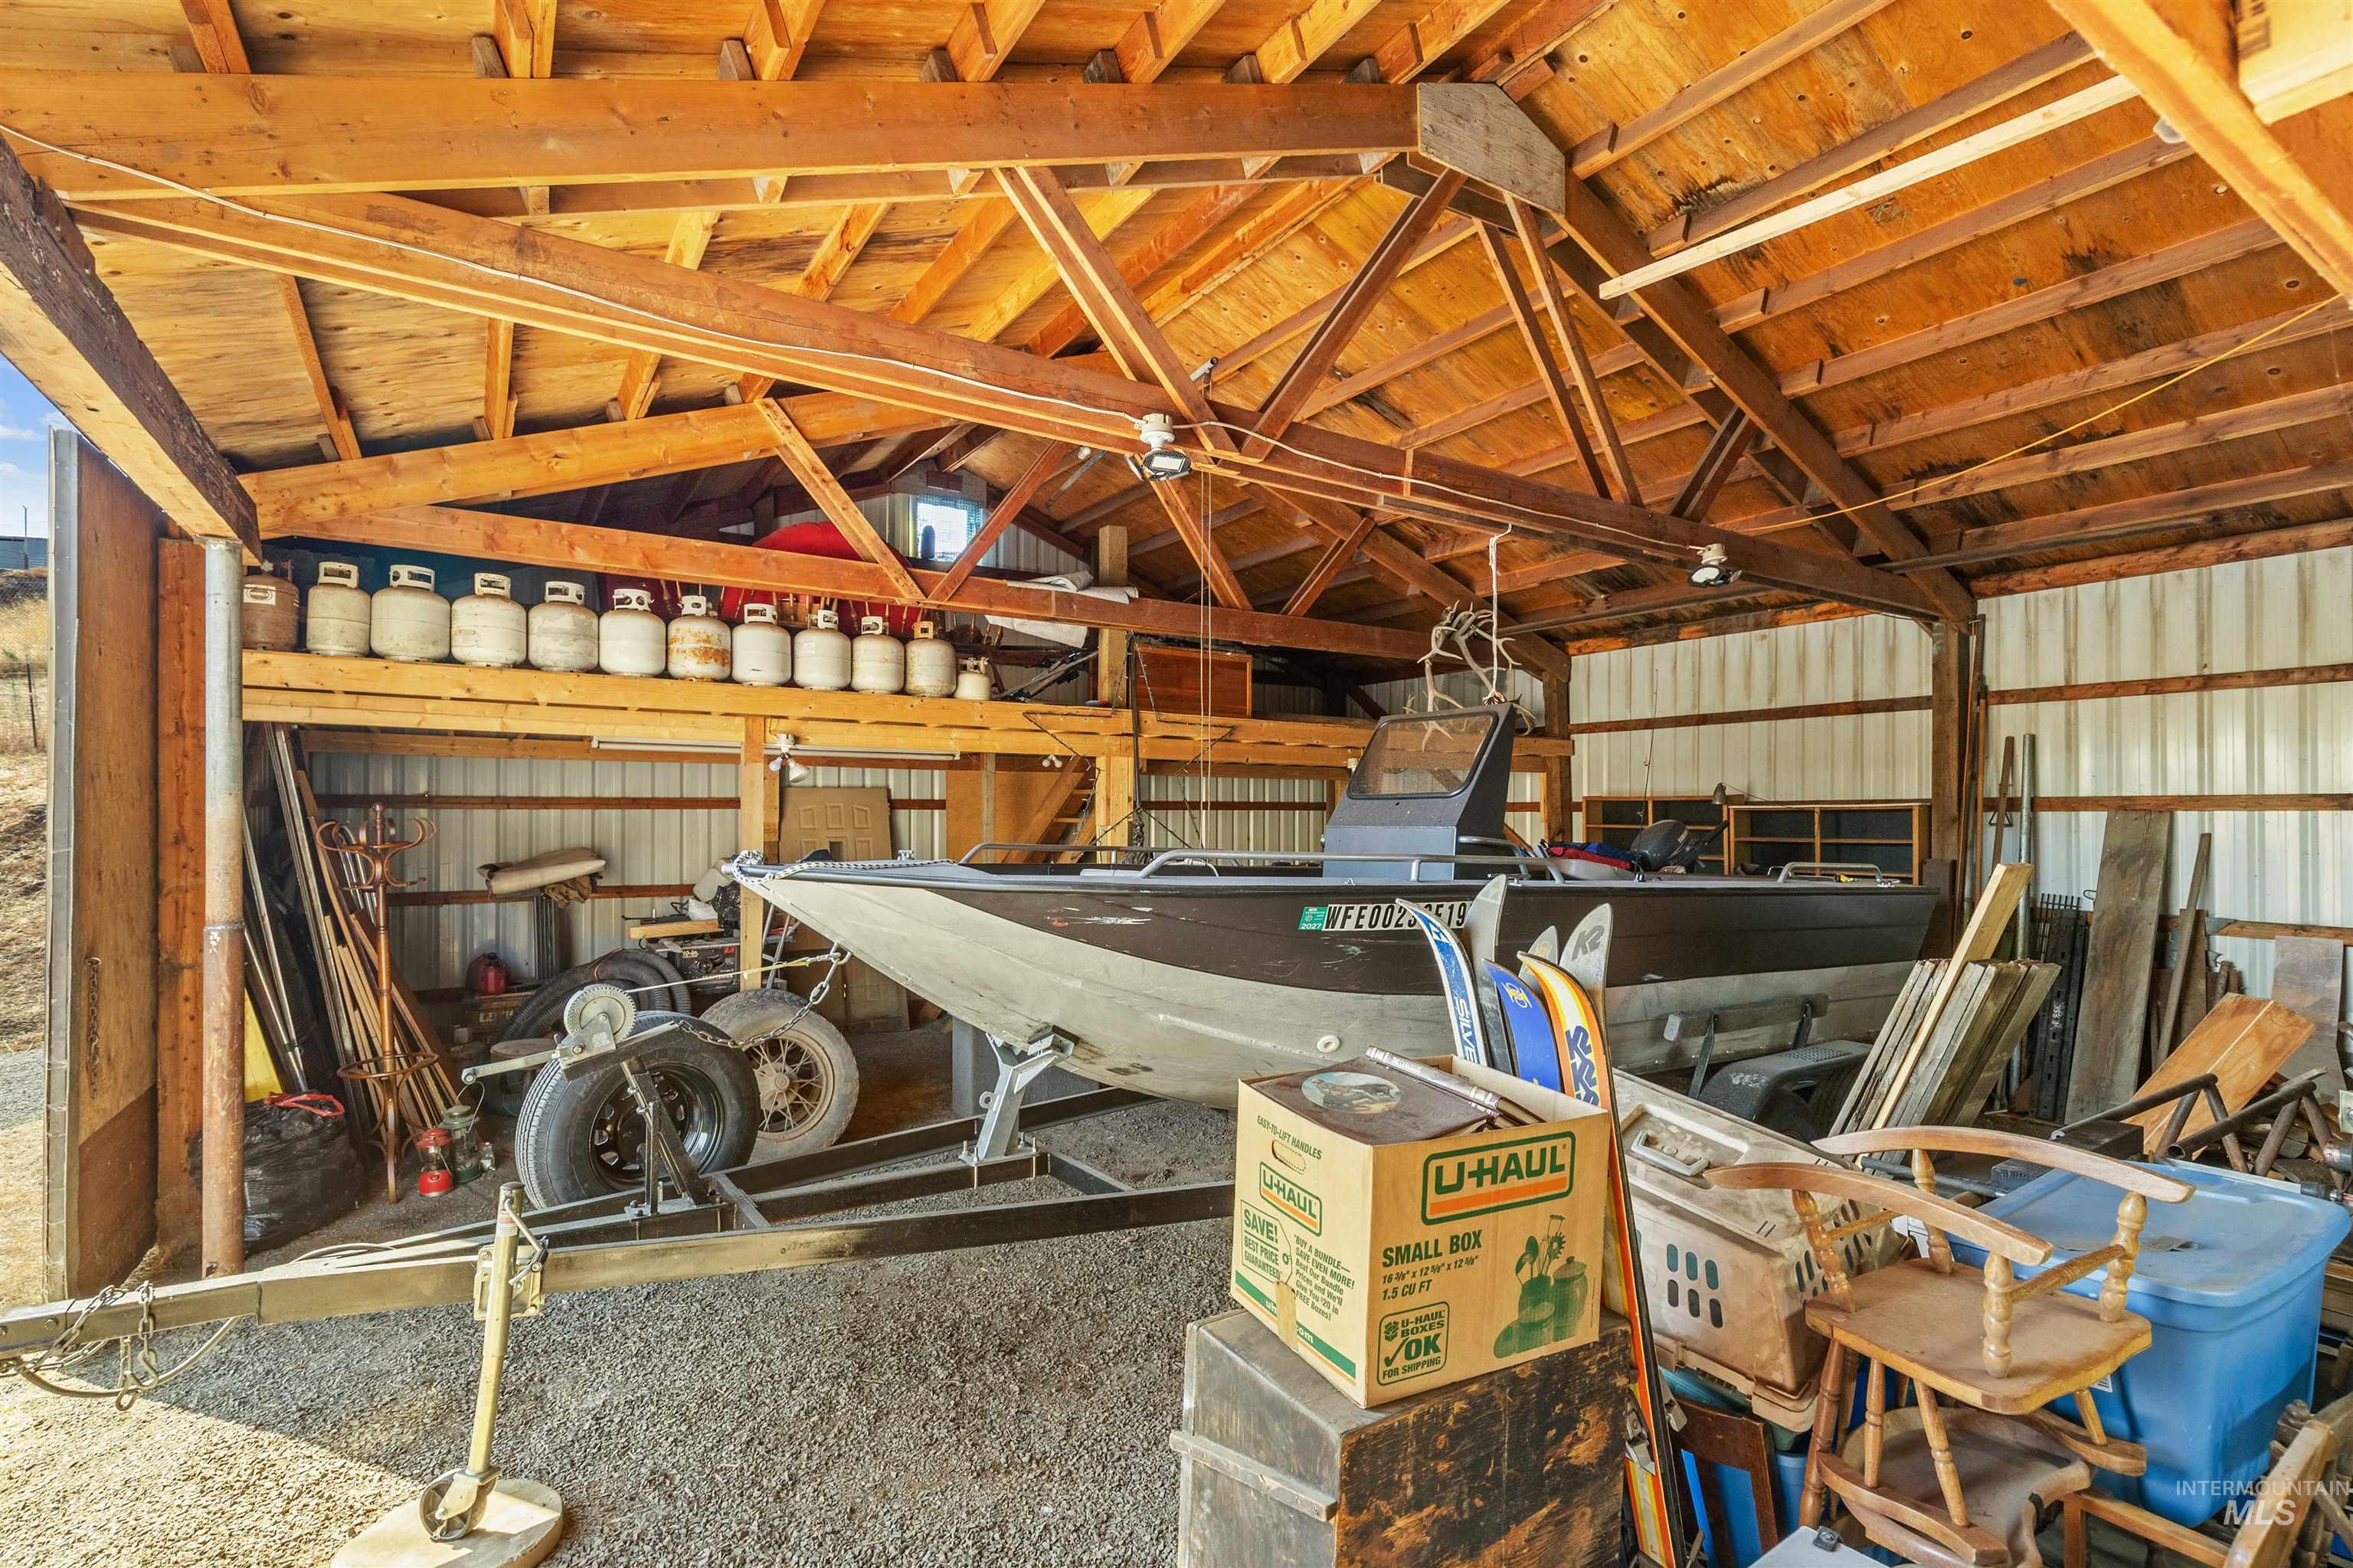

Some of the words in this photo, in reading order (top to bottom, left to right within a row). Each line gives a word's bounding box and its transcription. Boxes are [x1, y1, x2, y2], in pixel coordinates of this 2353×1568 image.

[1572, 925, 1605, 961] K2
[1565, 1025, 1593, 1061] K2
[1571, 1059, 1597, 1092] K2
[1257, 1115, 1291, 1144] EASY-TO-LIFT
[1291, 1138, 1323, 1160] HANDLES
[1435, 1145, 1566, 1195] U-HAUL
[1263, 1170, 1317, 1219] U-HAUL
[1243, 1208, 1278, 1244] SAVE!
[1244, 1236, 1258, 1253] BEST
[1260, 1242, 1279, 1266] PRICE
[1308, 1245, 1313, 1254] A
[1382, 1239, 1443, 1268] SMALL
[1449, 1229, 1483, 1255] BOX
[1295, 1247, 1311, 1263] SAVE
[1311, 1259, 1328, 1274] EVEN
[1330, 1269, 1355, 1289] MORE!
[1295, 1258, 1308, 1273] Beat
[1309, 1268, 1319, 1280] Our
[1320, 1276, 1343, 1295] Bundle
[1295, 1269, 1313, 1286] Prices
[1314, 1283, 1326, 1295] and
[1295, 1279, 1307, 1293] Give
[1309, 1288, 1320, 1302] You
[1332, 1304, 1339, 1315] in
[1295, 1291, 1310, 1306] FREE
[1311, 1301, 1331, 1321] Boxes!
[1383, 1287, 1399, 1301] 1.5
[1401, 1283, 1416, 1297] CU
[1419, 1279, 1432, 1293] FT
[1401, 1310, 1445, 1327] U-HAUL
[1401, 1320, 1445, 1337] BOXES
[1404, 1333, 1442, 1360] OK
[1383, 1367, 1399, 1379] FOR
[1401, 1356, 1441, 1374] SHIPPING
